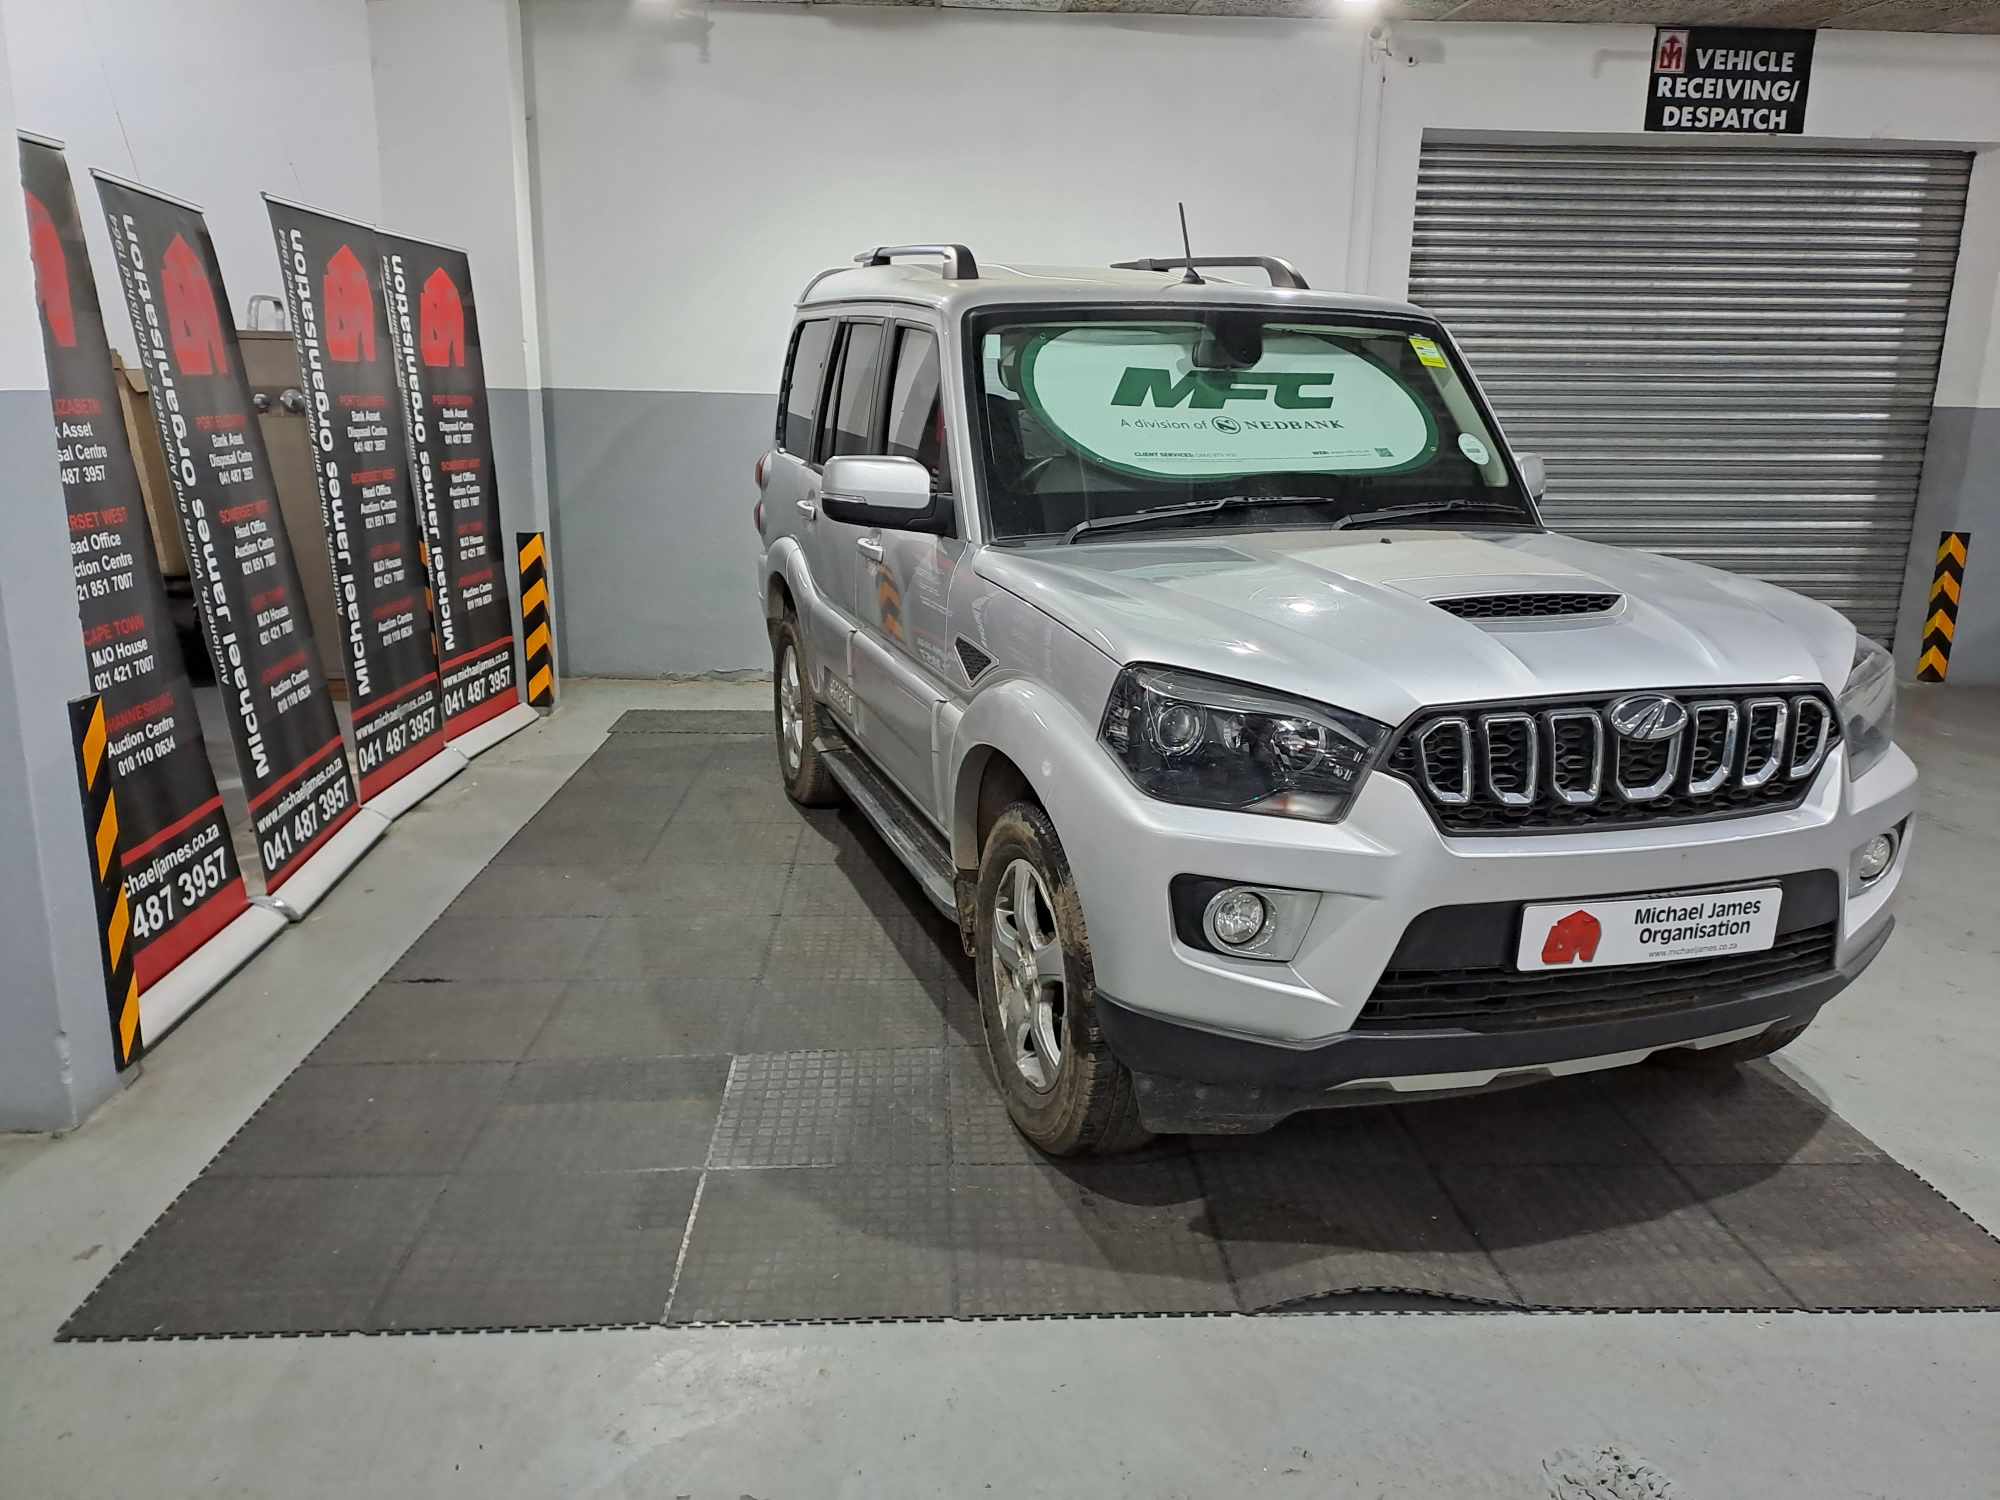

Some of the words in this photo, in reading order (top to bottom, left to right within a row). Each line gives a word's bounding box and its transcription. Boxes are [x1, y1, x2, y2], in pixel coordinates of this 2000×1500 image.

[1695, 48, 1796, 73] VEHICLE
[1656, 76, 1801, 102] RECEIVING/
[1662, 105, 1787, 130] DESPATCH
[122, 214, 197, 487] Organisation
[290, 228, 334, 452] Organisation
[392, 255, 427, 443] Organisation
[1111, 367, 1335, 410] MFC
[63, 421, 93, 438] Asset
[1120, 418, 1131, 428] A
[1134, 418, 1190, 430] division
[1193, 420, 1207, 430] of
[1243, 419, 1345, 430] NEDBANK
[75, 444, 108, 460] Centre
[62, 467, 80, 484] 487
[83, 465, 106, 482] 3957
[325, 462, 351, 566] James
[420, 451, 440, 540] James
[91, 532, 121, 550] Office
[102, 552, 133, 570] Centre
[191, 499, 232, 623] James
[90, 579, 110, 598] 851
[432, 547, 455, 651] Michael
[92, 646, 114, 668] MJO
[116, 638, 148, 659] House
[340, 574, 371, 697] Michael
[95, 670, 112, 691] 021
[114, 663, 132, 682] 421
[133, 654, 154, 676] 7007
[444, 689, 465, 716] 041
[467, 678, 486, 703] 487
[489, 666, 511, 694] 3957
[222, 632, 271, 779] Michael
[108, 730, 144, 759] Auction
[146, 715, 175, 739] Centre
[358, 738, 383, 772] 041
[385, 723, 407, 755] 487
[408, 707, 435, 741] 3957
[118, 759, 135, 777] 010
[135, 748, 153, 767] 110
[263, 825, 293, 871] 041
[294, 802, 318, 843] 487
[319, 776, 349, 821] 3957
[133, 884, 174, 938] 487
[178, 846, 227, 907] 3957
[1634, 903, 1704, 925] Michael
[1707, 900, 1761, 919] James
[1639, 920, 1751, 945] Organisation
